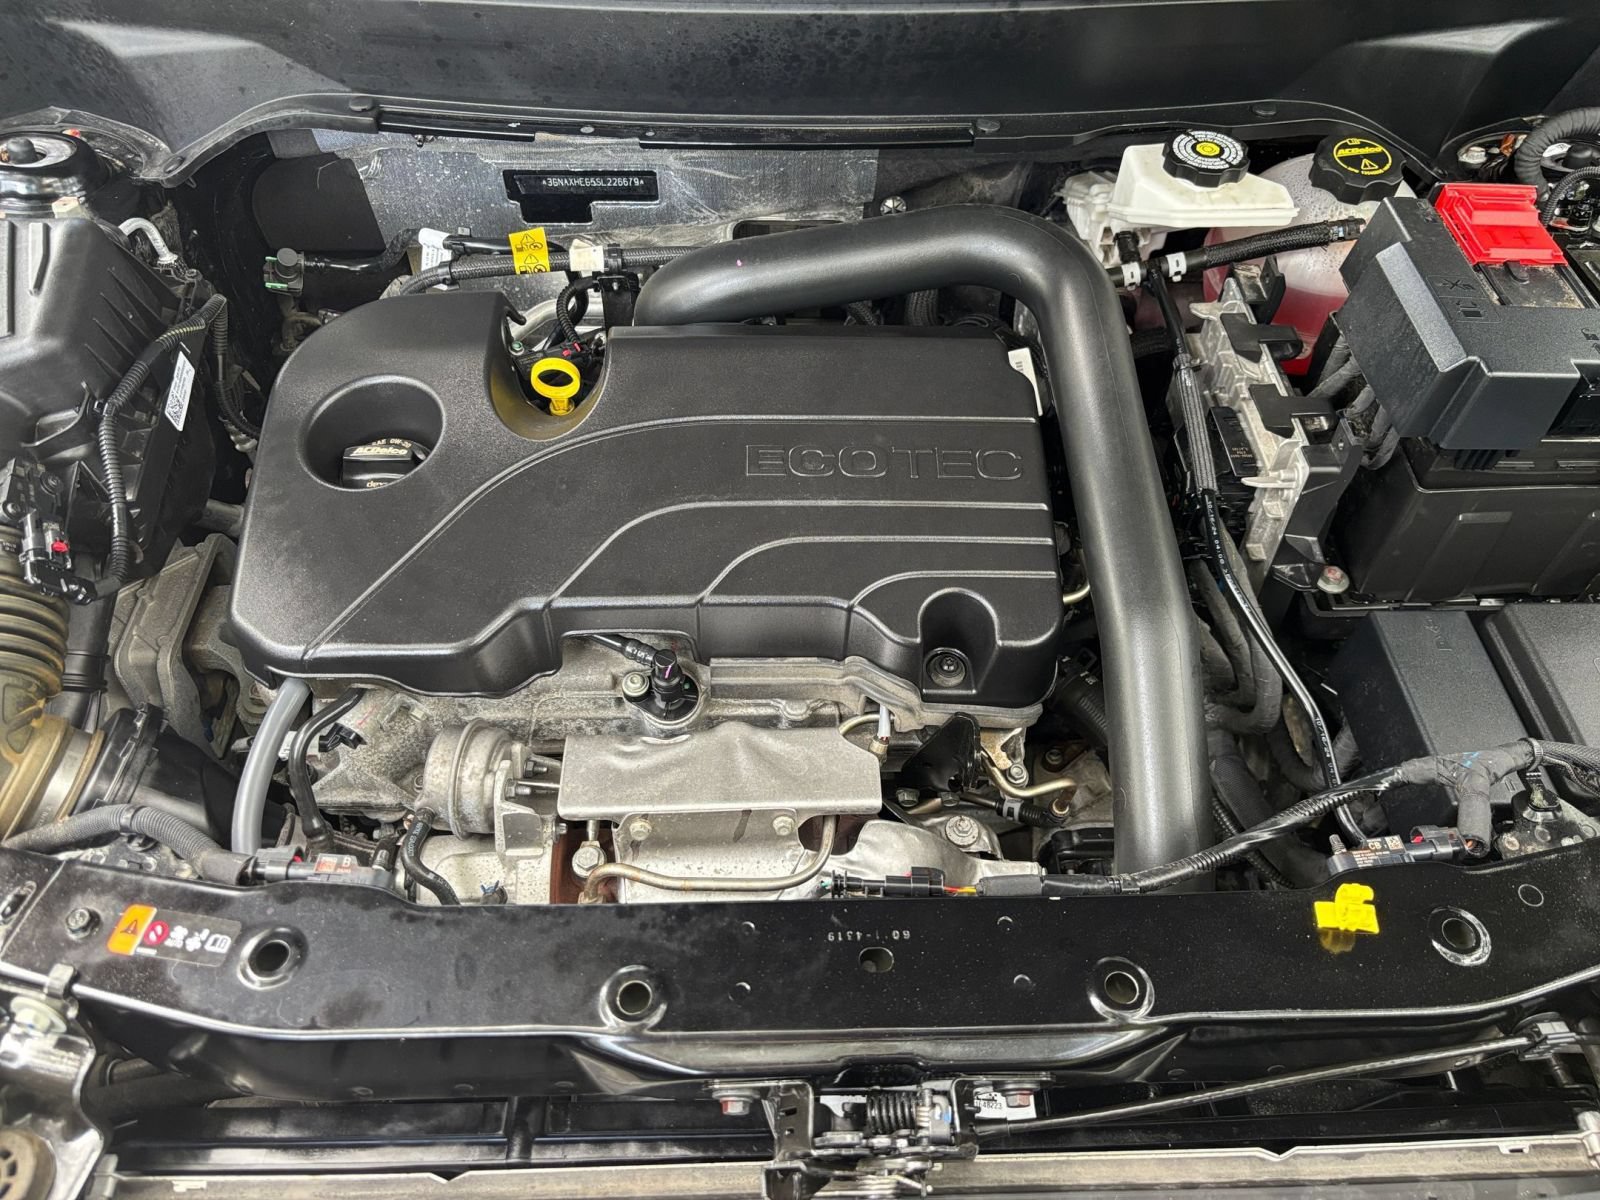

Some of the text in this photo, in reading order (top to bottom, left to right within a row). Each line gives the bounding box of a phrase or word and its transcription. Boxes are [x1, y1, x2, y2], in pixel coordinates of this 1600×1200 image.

[350, 446, 409, 457] ACDelco
[746, 444, 1022, 480] ECOTEC
[1368, 841, 1382, 850] CB
